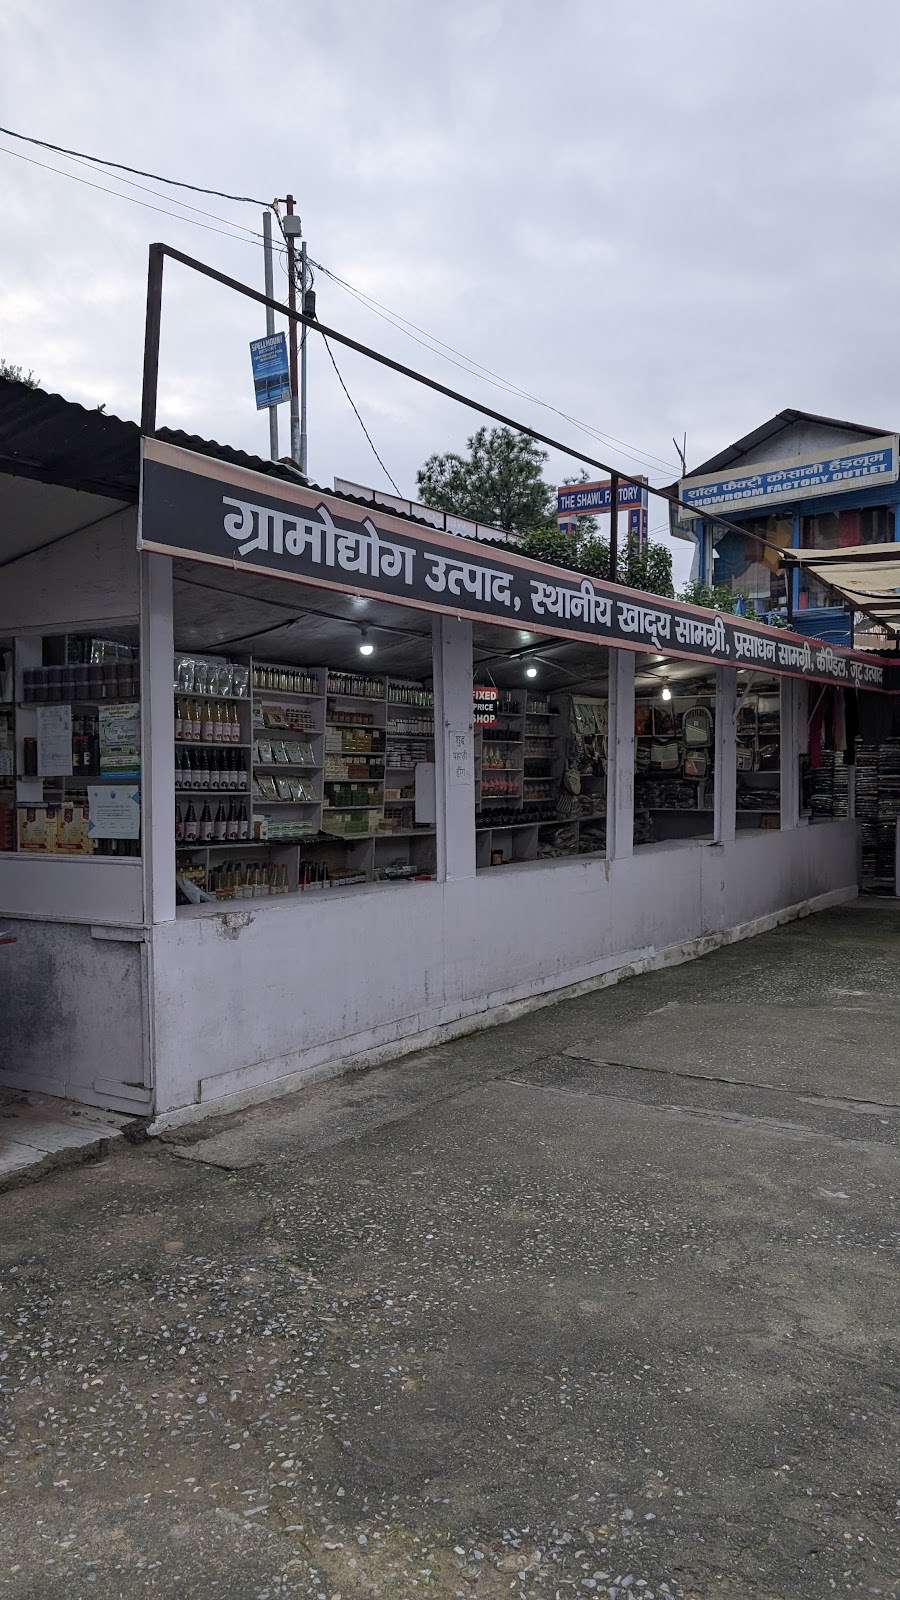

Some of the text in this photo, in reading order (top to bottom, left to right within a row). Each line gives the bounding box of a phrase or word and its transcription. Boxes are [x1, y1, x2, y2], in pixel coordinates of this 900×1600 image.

[251, 335, 283, 351] SPELLMOUNT
[686, 487, 764, 508] SHOWROOM
[766, 474, 830, 495] FACTORY
[832, 463, 888, 481] OUTLET
[560, 495, 575, 509] THE
[576, 491, 603, 508] SHAWL
[222, 495, 417, 585] ग्रामोद्योग
[423, 552, 522, 612] उत्पाद,
[530, 579, 613, 627] स्थानीय
[674, 616, 730, 655] सामग्री,
[733, 631, 778, 663] प्रसाधन
[778, 641, 814, 673] सामग्री,
[849, 660, 863, 688] जूट
[863, 664, 884, 684] उत्पाद
[473, 703, 494, 711] PRICE
